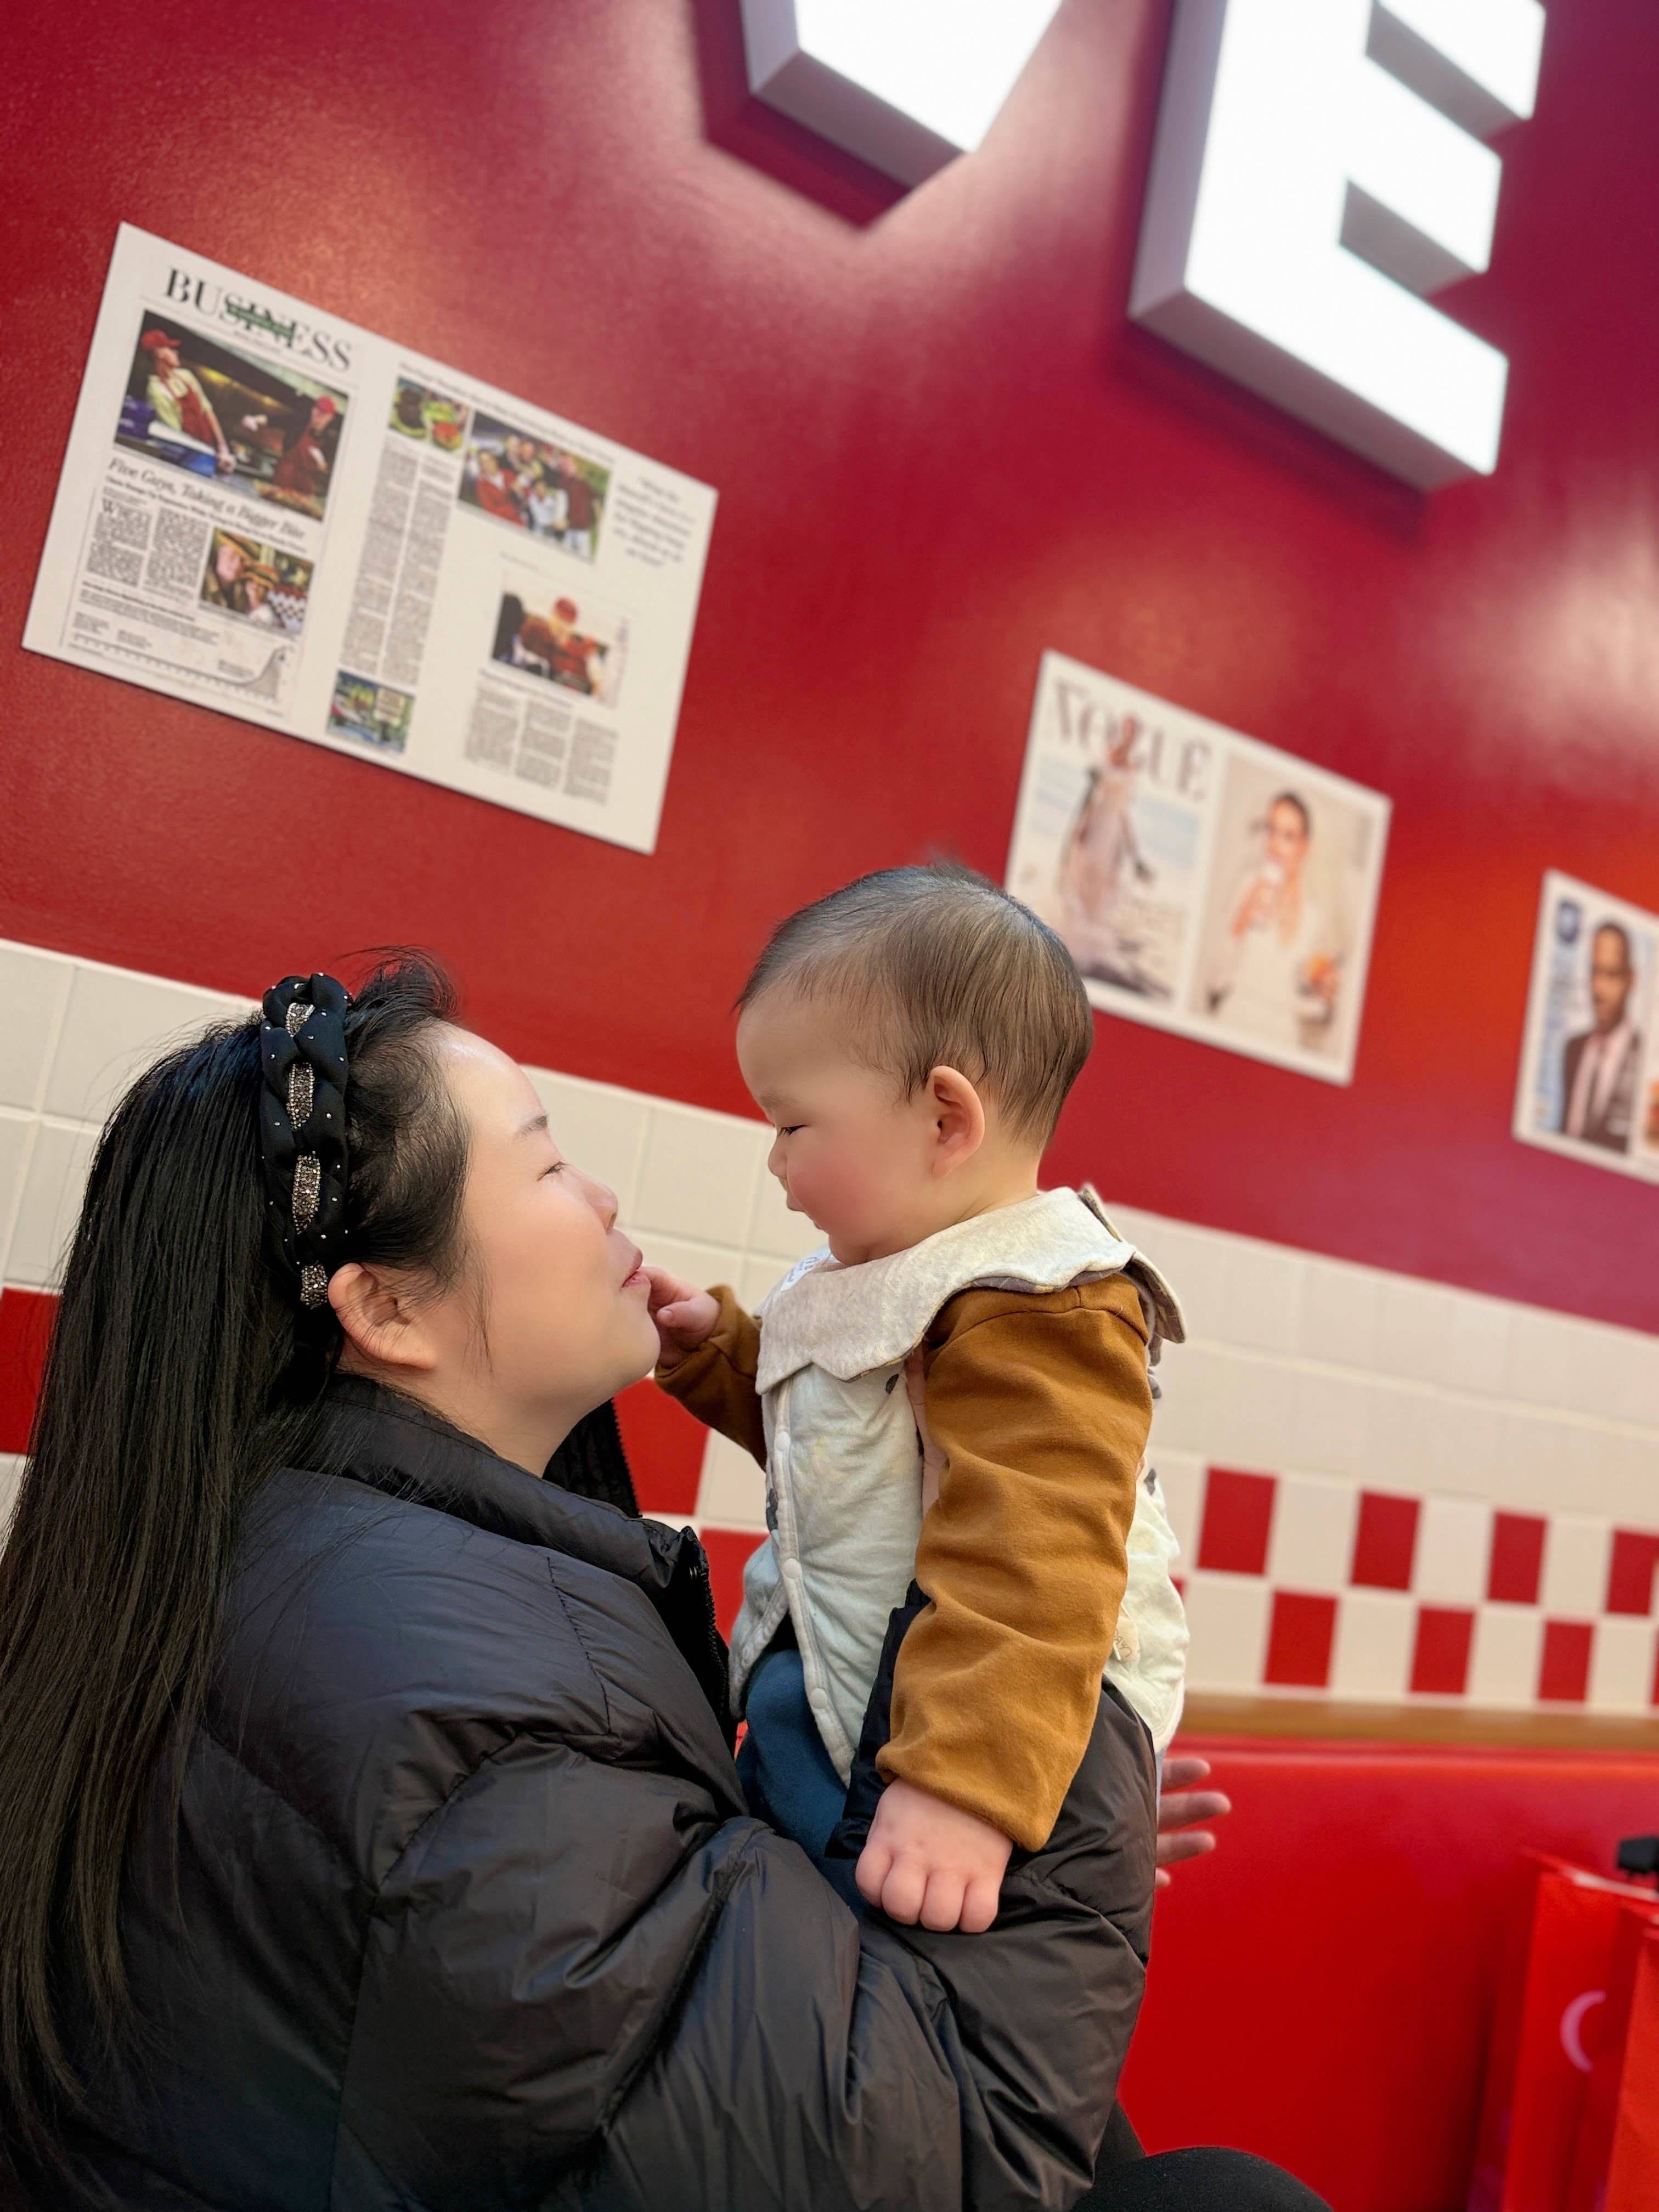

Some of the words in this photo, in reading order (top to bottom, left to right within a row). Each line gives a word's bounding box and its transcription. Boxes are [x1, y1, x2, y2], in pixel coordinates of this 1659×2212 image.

[166, 267, 352, 373] BUSINESS
[108, 457, 138, 478] Five
[141, 469, 176, 495] Guys,
[182, 483, 225, 512] Taking
[227, 503, 236, 515] a
[238, 504, 278, 531] Bigger
